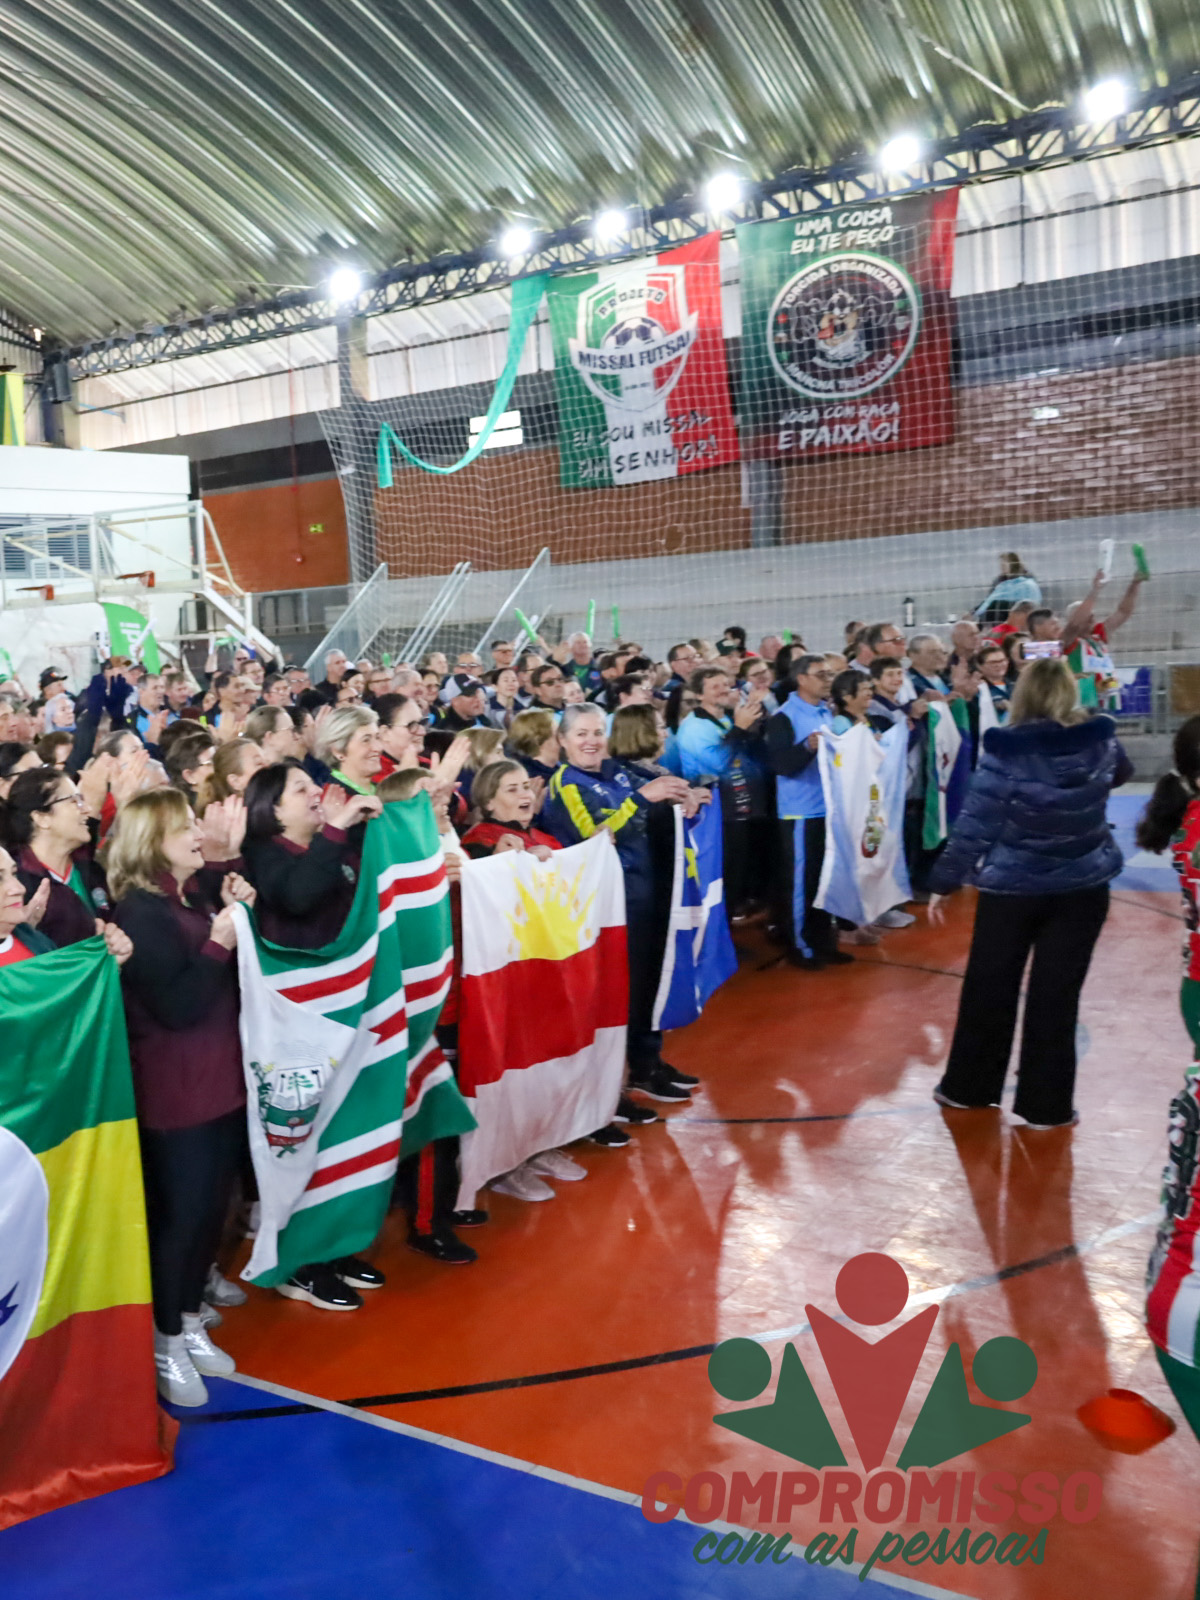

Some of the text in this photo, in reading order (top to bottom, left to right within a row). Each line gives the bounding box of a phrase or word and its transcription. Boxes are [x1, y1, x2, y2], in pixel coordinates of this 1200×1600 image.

[794, 206, 893, 237] UMA COISA
[790, 225, 895, 255] EU TE PEÇO
[781, 260, 904, 309] TORCIDA ORGANIZADA
[598, 287, 665, 316] PROJETO
[578, 330, 691, 371] MISSAL FUTSAL
[642, 409, 713, 437] MISSAL
[777, 429, 795, 451] E
